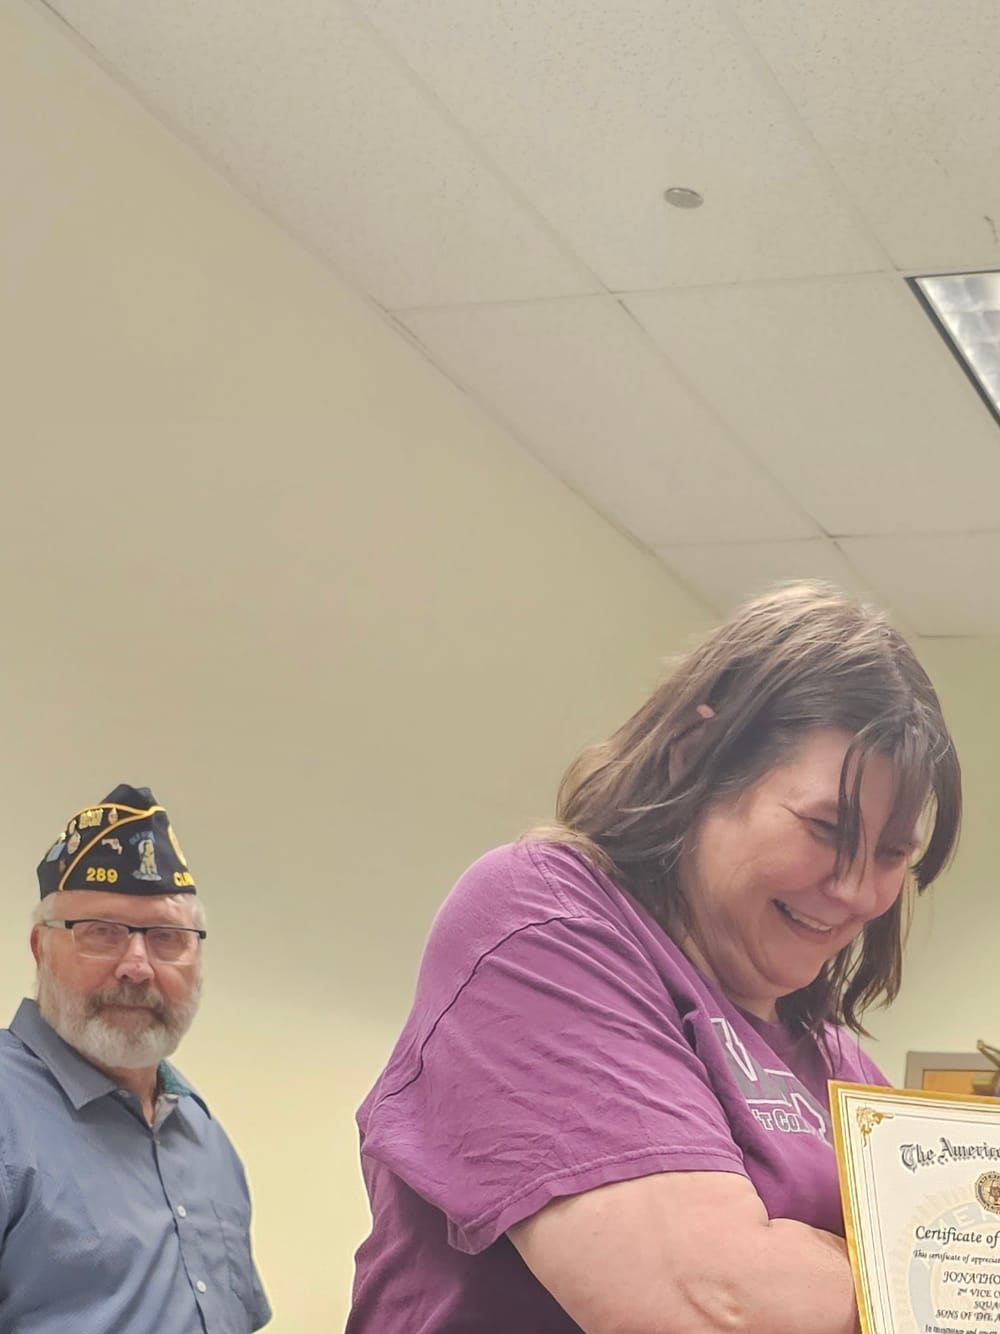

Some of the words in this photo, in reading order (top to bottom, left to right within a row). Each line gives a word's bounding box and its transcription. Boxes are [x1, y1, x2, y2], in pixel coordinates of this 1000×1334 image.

[86, 867, 119, 884] 289
[900, 1143, 936, 1173] The
[915, 1225, 983, 1245] Certificate
[985, 1230, 1000, 1249] of
[929, 1251, 961, 1263] certificate
[961, 1253, 971, 1264] of
[969, 1289, 992, 1299] VICE
[935, 1309, 960, 1321] SONS
[960, 1310, 974, 1322] OF
[973, 1312, 994, 1323] THE
